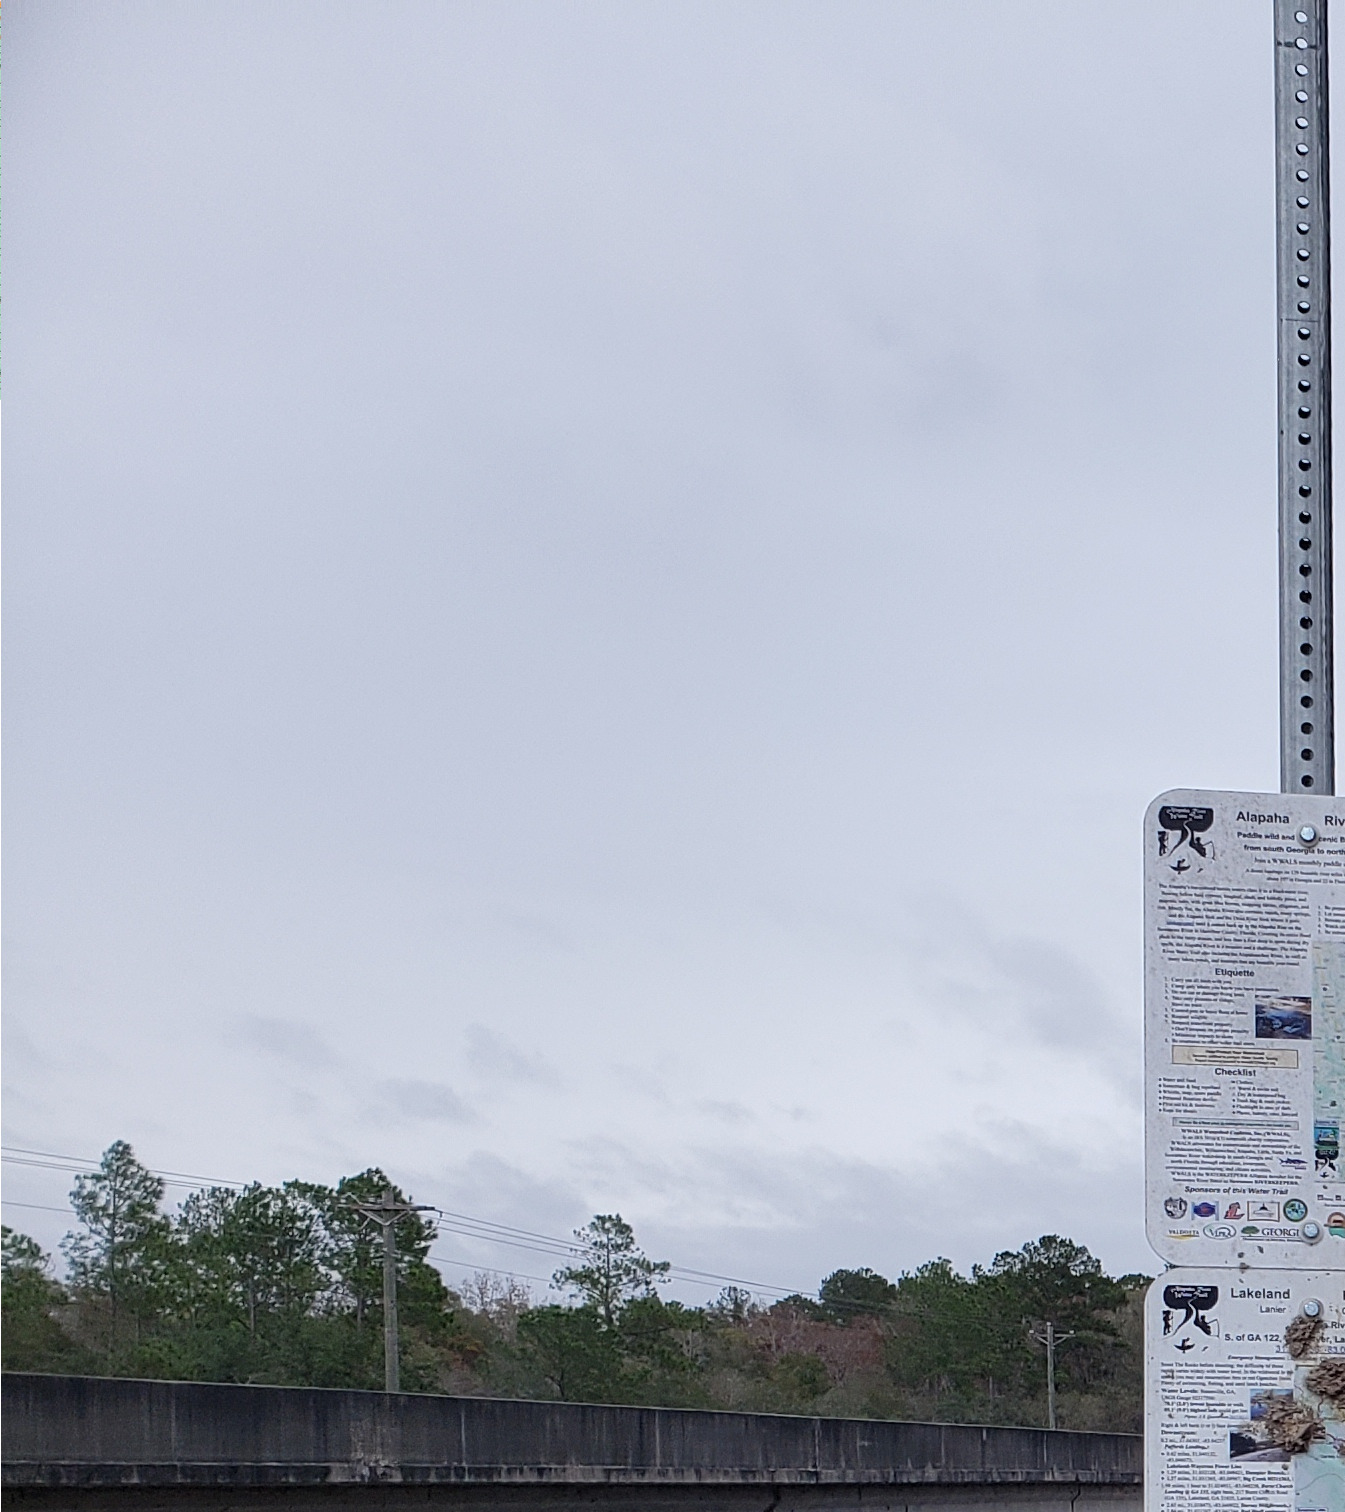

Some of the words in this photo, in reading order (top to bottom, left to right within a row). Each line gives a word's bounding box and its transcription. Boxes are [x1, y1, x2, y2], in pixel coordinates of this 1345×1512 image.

[1236, 811, 1290, 825] Alapaha
[1237, 831, 1262, 840] Paddle
[1243, 844, 1262, 852] from
[1263, 845, 1285, 853] south
[1286, 846, 1315, 856] Georgia
[1326, 848, 1345, 856] north
[1215, 967, 1255, 978] Etiquette
[1214, 1067, 1257, 1077] Checklist
[1184, 1185, 1221, 1194] Sponsors
[1222, 1186, 1232, 1195] of
[1232, 1186, 1246, 1194] this
[1248, 1187, 1268, 1195] Water
[1270, 1187, 1289, 1195] Trail
[1261, 1227, 1300, 1238] GEORGI
[1231, 1287, 1291, 1300] Lakeland
[1260, 1305, 1287, 1314] Lanier
[1224, 1334, 1234, 1342] S.
[1236, 1334, 1245, 1342] of
[1247, 1334, 1262, 1342] GA
[1265, 1334, 1282, 1344] 122,
